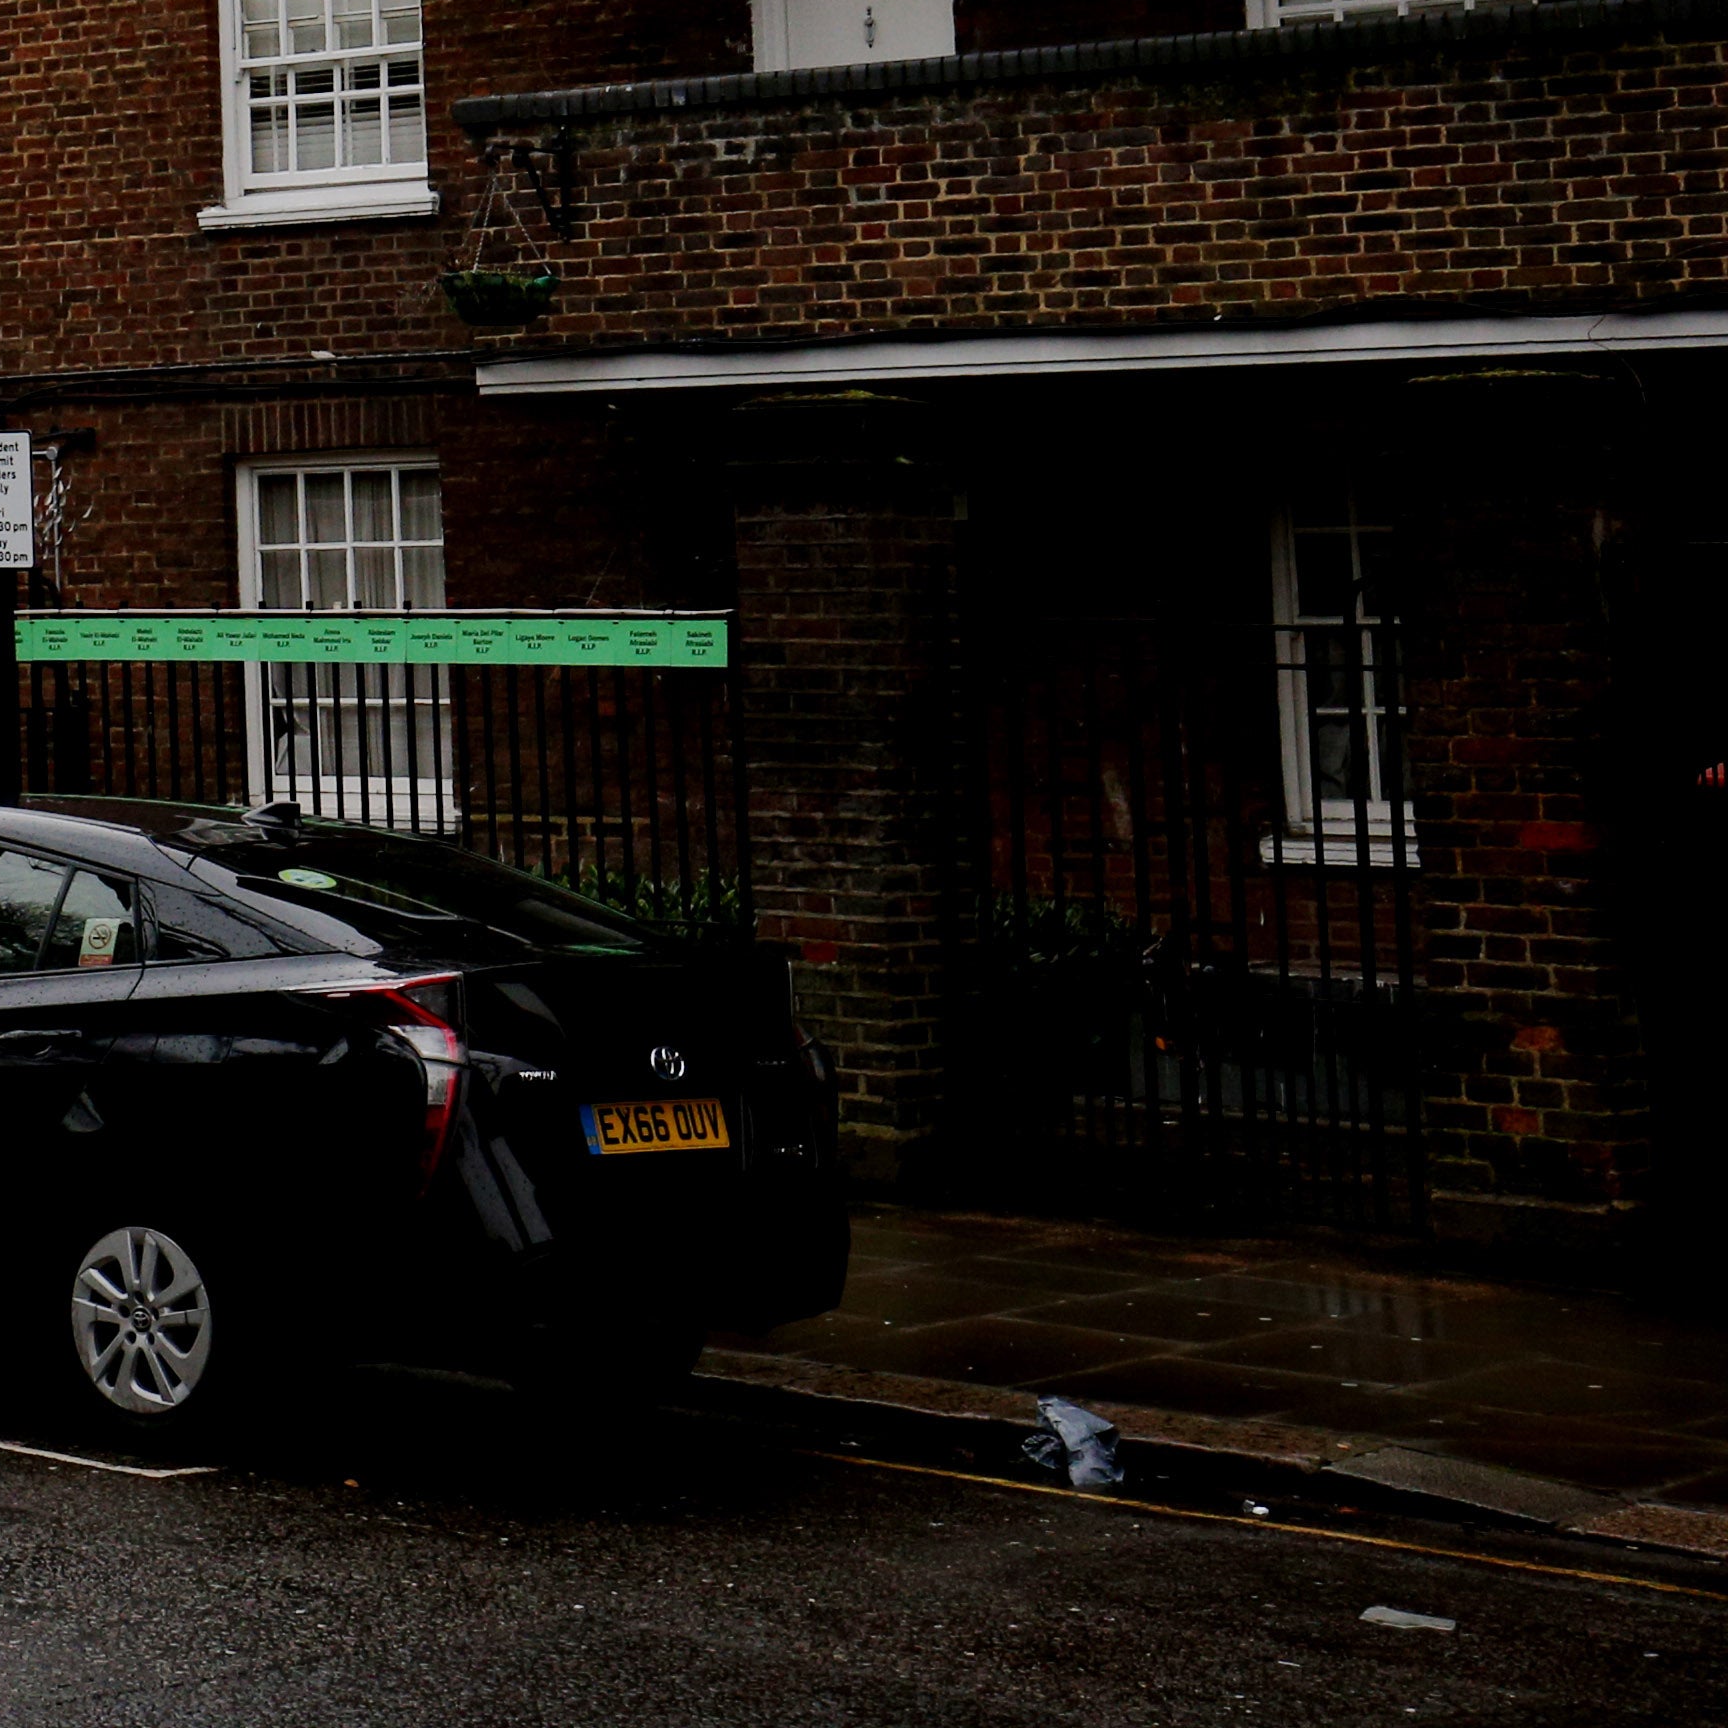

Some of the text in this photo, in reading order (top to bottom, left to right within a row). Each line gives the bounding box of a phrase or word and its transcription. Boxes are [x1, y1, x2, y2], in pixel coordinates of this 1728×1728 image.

[13, 523, 28, 533] pm
[13, 553, 28, 564] pm
[597, 1103, 721, 1145] EX66 OUV
